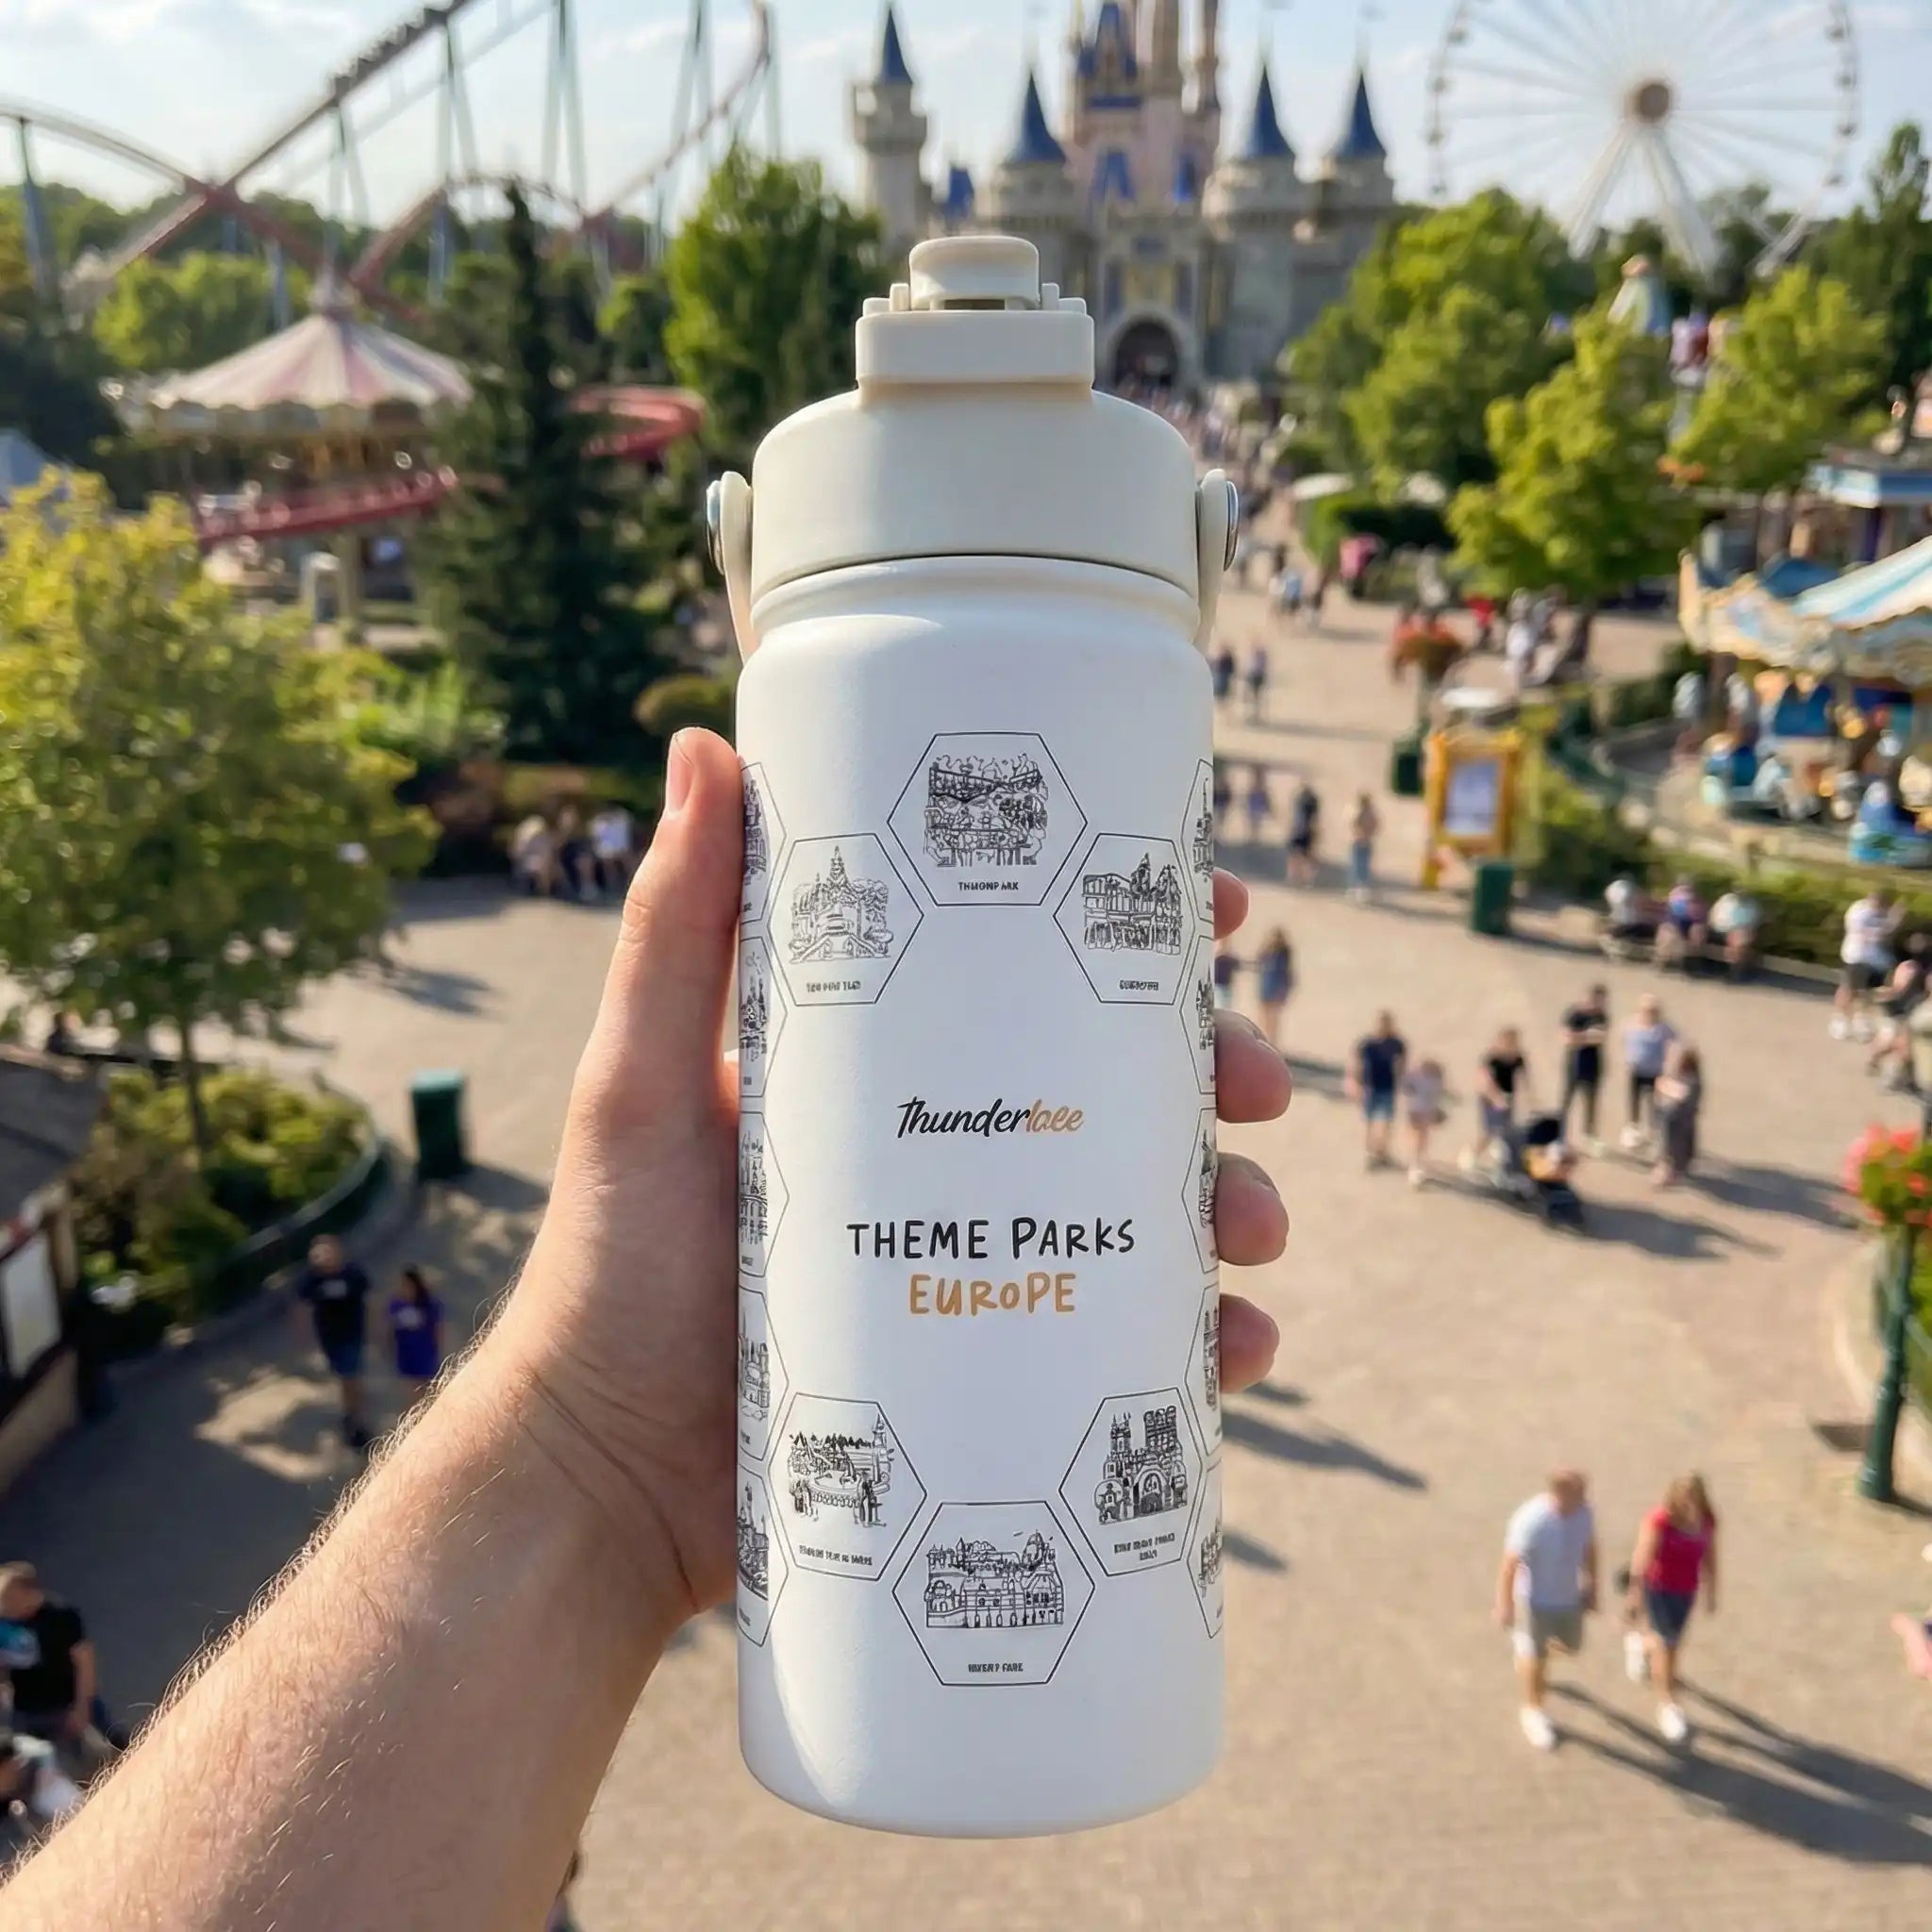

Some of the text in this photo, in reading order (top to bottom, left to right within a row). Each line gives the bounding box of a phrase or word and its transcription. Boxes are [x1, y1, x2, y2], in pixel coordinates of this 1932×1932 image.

[846, 1216, 1135, 1260] THEME PARKS
[909, 1272, 1076, 1317] EUROPE
